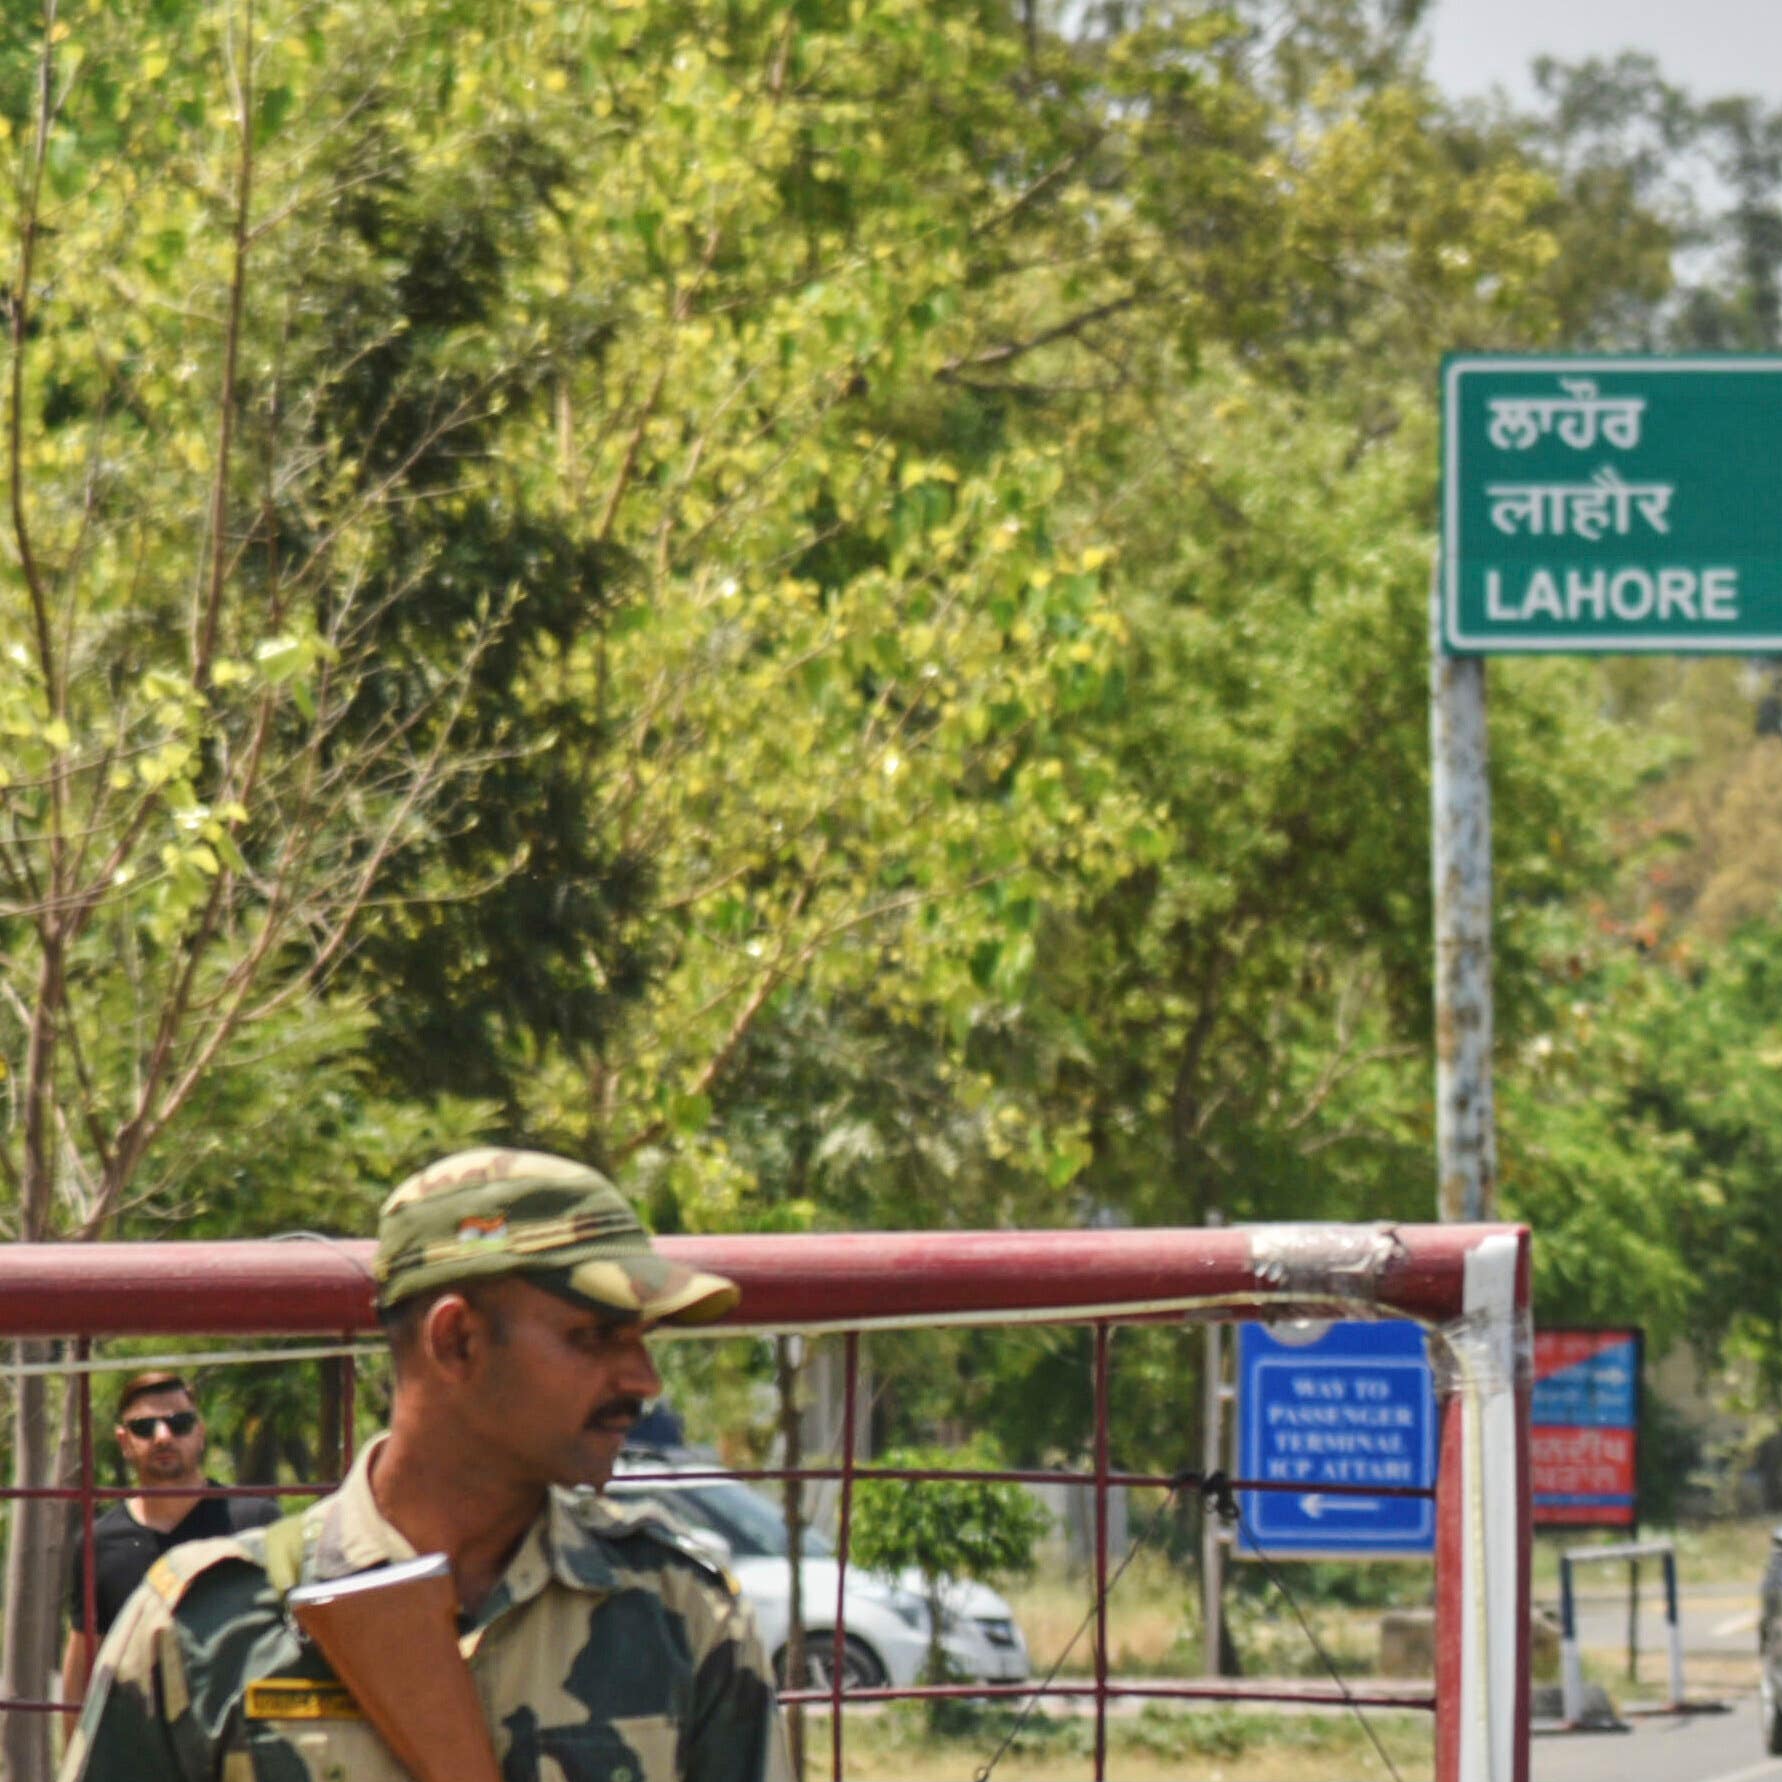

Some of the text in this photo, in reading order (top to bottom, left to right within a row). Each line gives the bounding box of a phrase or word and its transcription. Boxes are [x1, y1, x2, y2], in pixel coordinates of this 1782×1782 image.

[1488, 378, 1646, 449] ਲਾਹੌਰ
[1487, 466, 1673, 540] लाहौर
[1486, 567, 1738, 620] LAHORE
[1292, 1376, 1391, 1401] WAY TO
[1268, 1403, 1413, 1428] PASSENGER
[1274, 1430, 1404, 1455] TERMINAL
